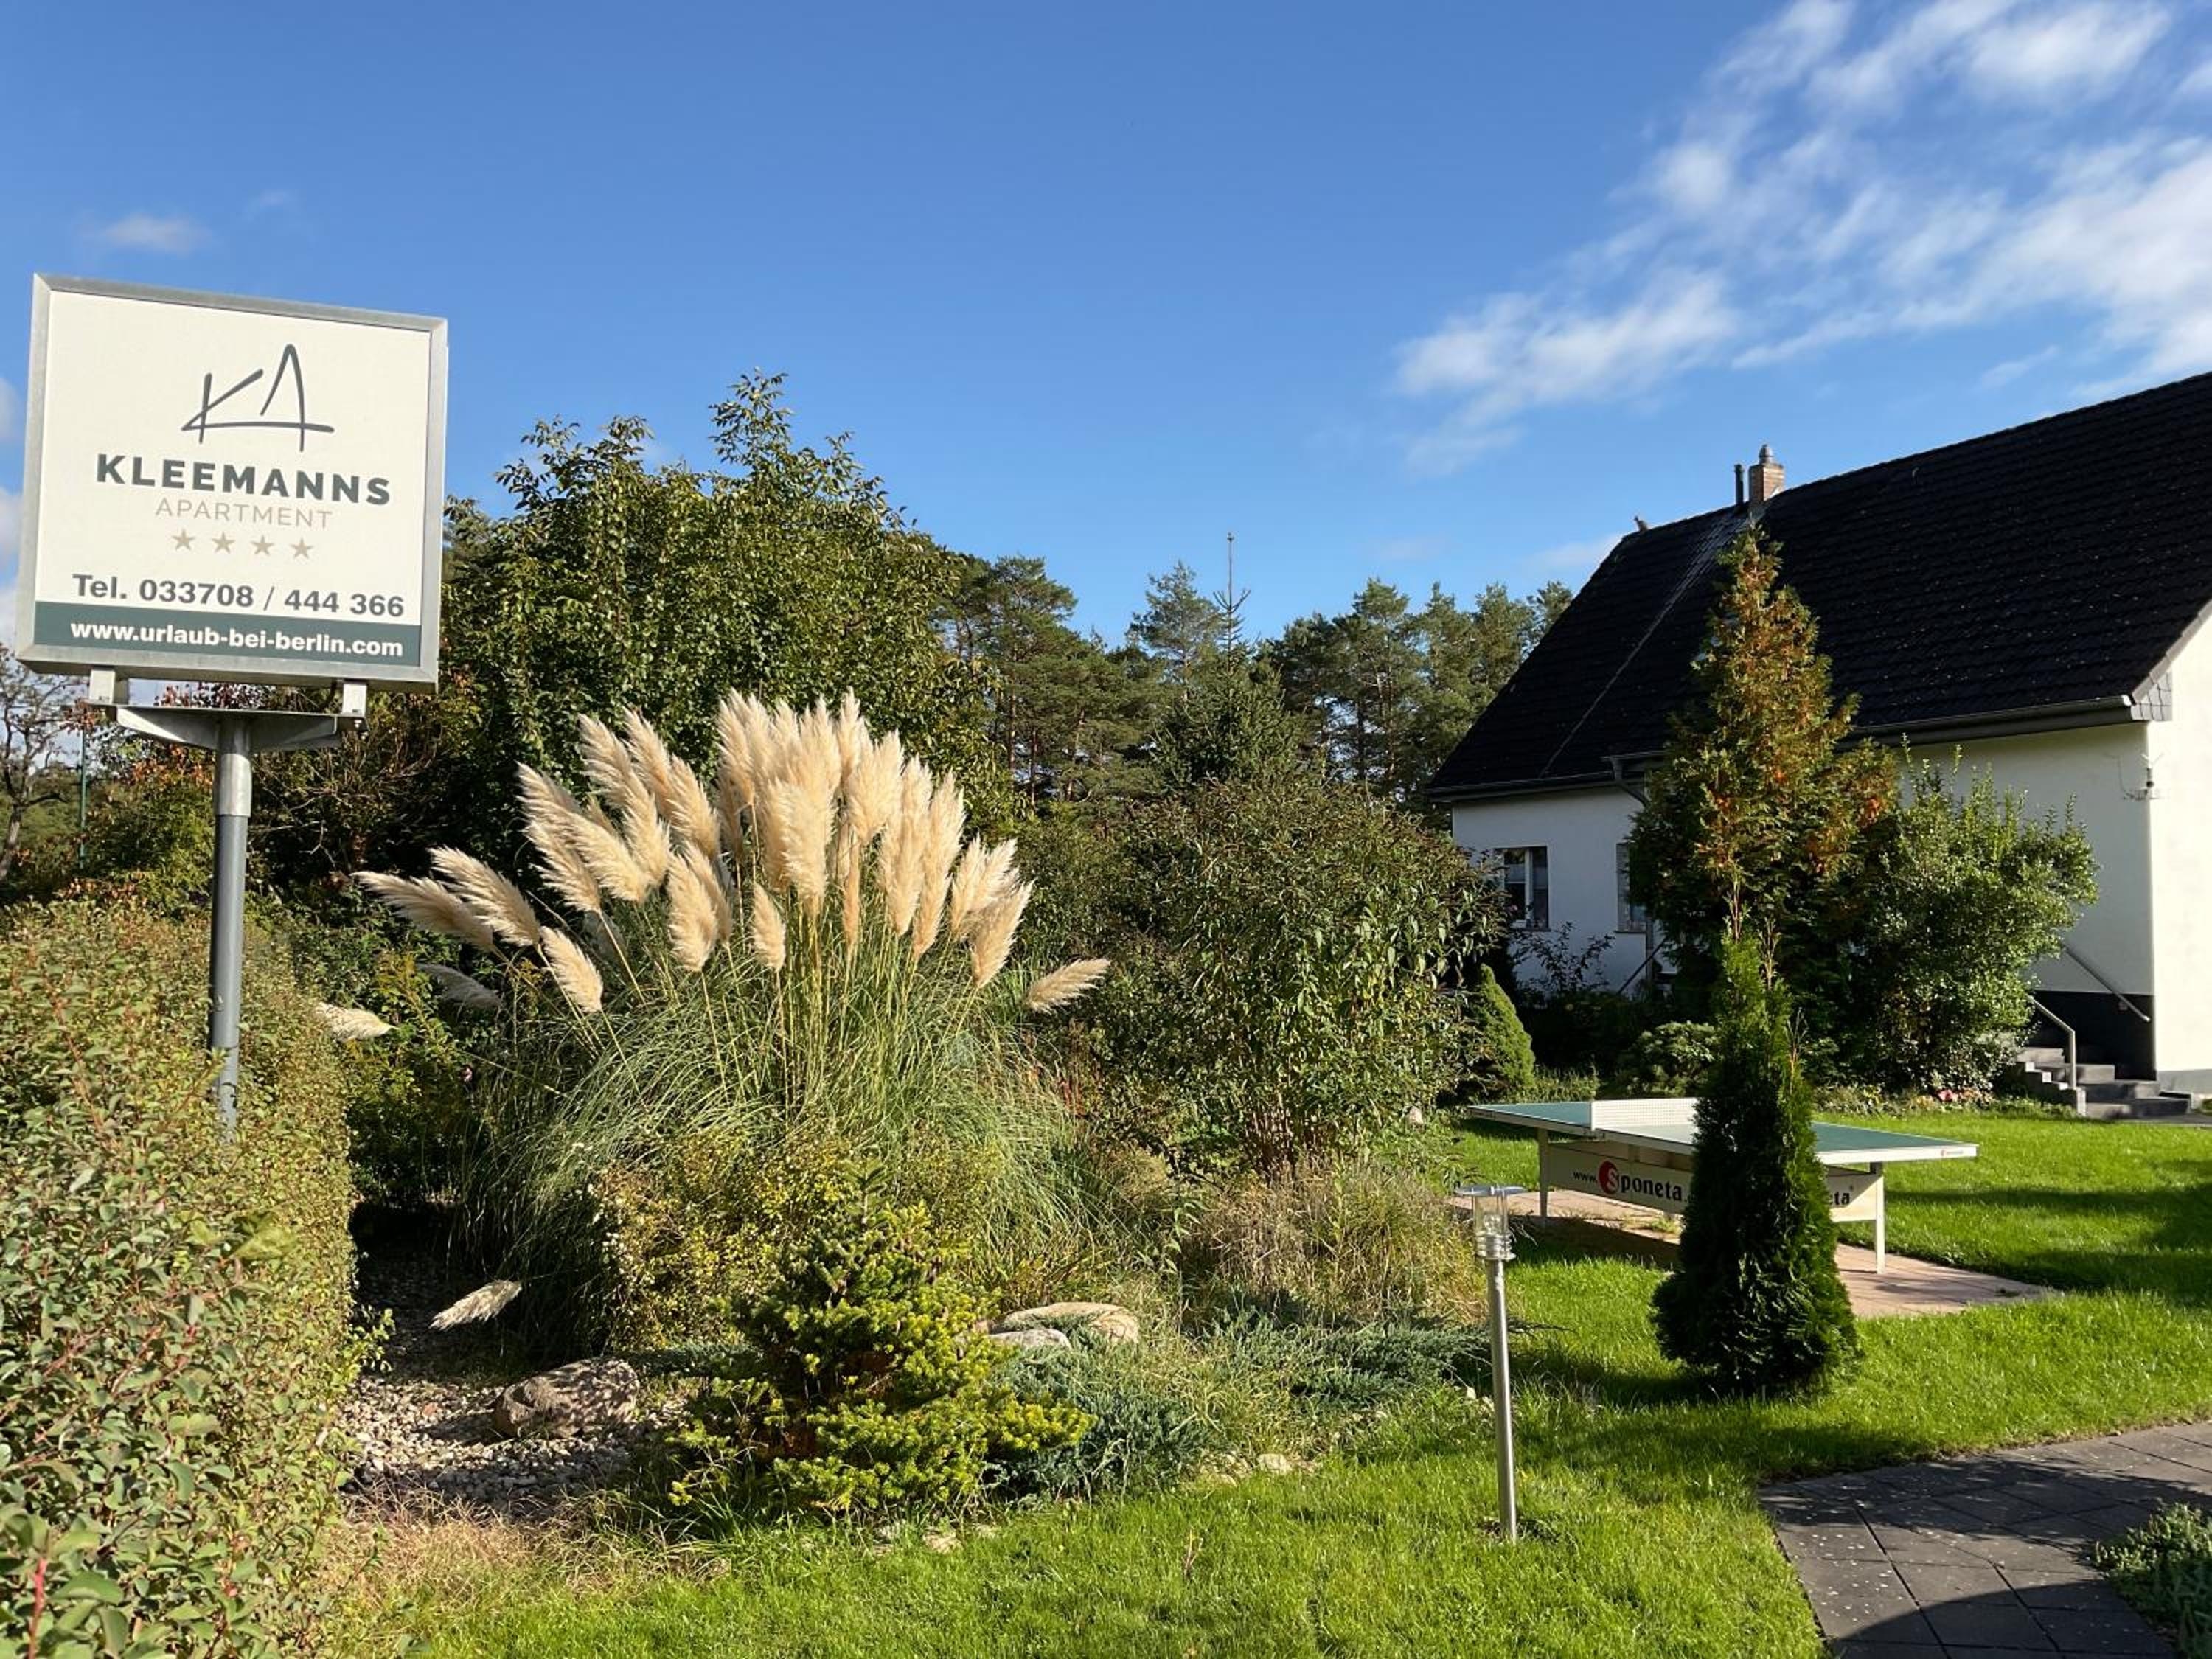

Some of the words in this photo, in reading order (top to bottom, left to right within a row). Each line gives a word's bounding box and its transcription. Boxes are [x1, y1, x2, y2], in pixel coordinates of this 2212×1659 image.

[97, 453, 390, 506] KLEEMANNS
[155, 498, 333, 529] APARTMENT
[72, 574, 128, 599] Tel.
[139, 579, 254, 608] 033708
[263, 586, 275, 611] /
[285, 589, 340, 613] 444
[349, 593, 404, 617] 366
[70, 623, 403, 657] www.urlaub-bei-berlin.com
